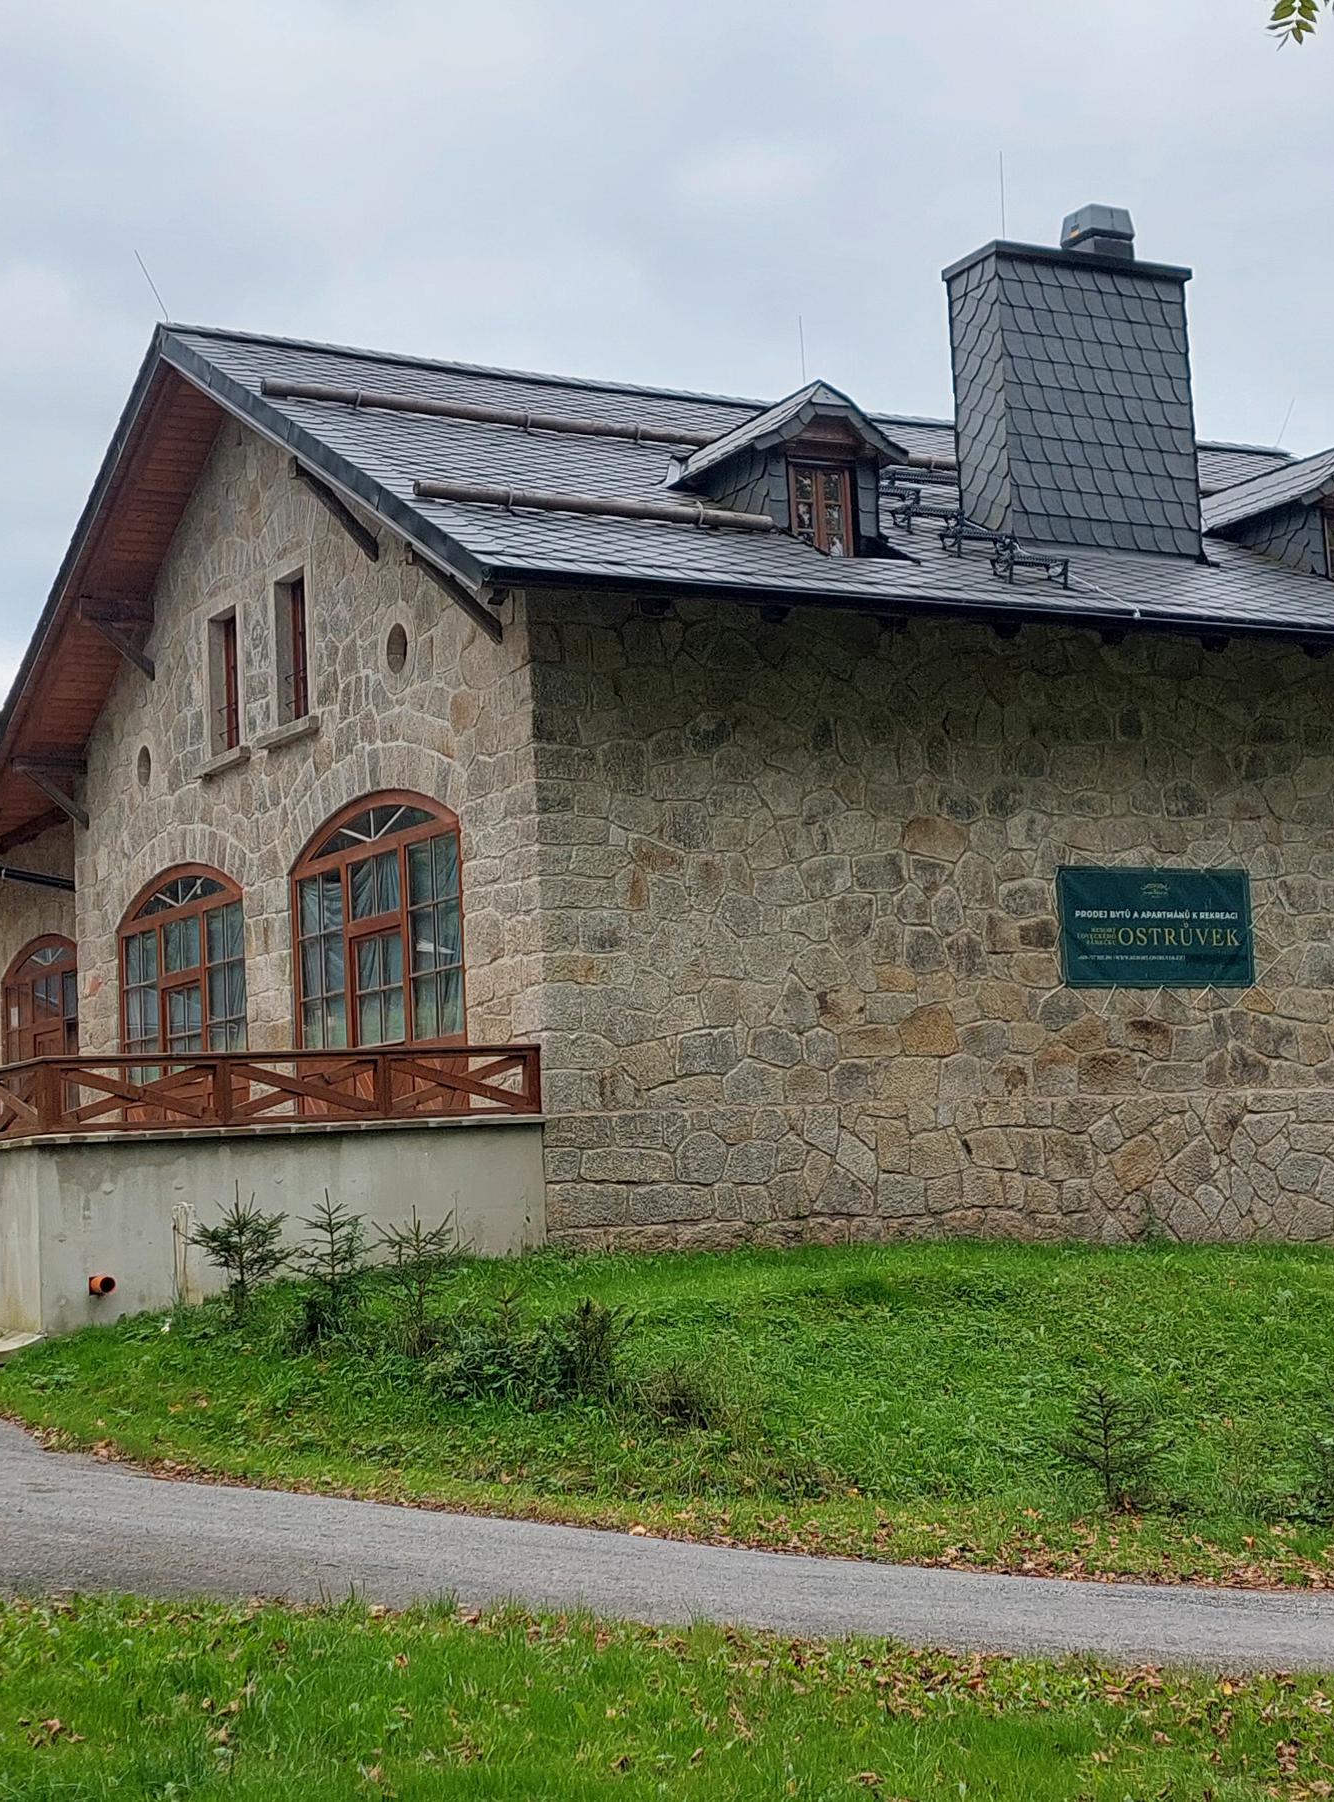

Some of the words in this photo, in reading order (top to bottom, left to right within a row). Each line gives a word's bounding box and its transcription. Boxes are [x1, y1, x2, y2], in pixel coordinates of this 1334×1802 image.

[1075, 910, 1108, 919] PRODEJ
[1110, 909, 1130, 919] BYTŮ
[1132, 911, 1139, 919] A
[1140, 909, 1190, 920] APARTMÁNŮ
[1192, 911, 1198, 919] K
[1199, 911, 1238, 920] REKREACI
[1118, 922, 1241, 946] OSTRŮVEK
